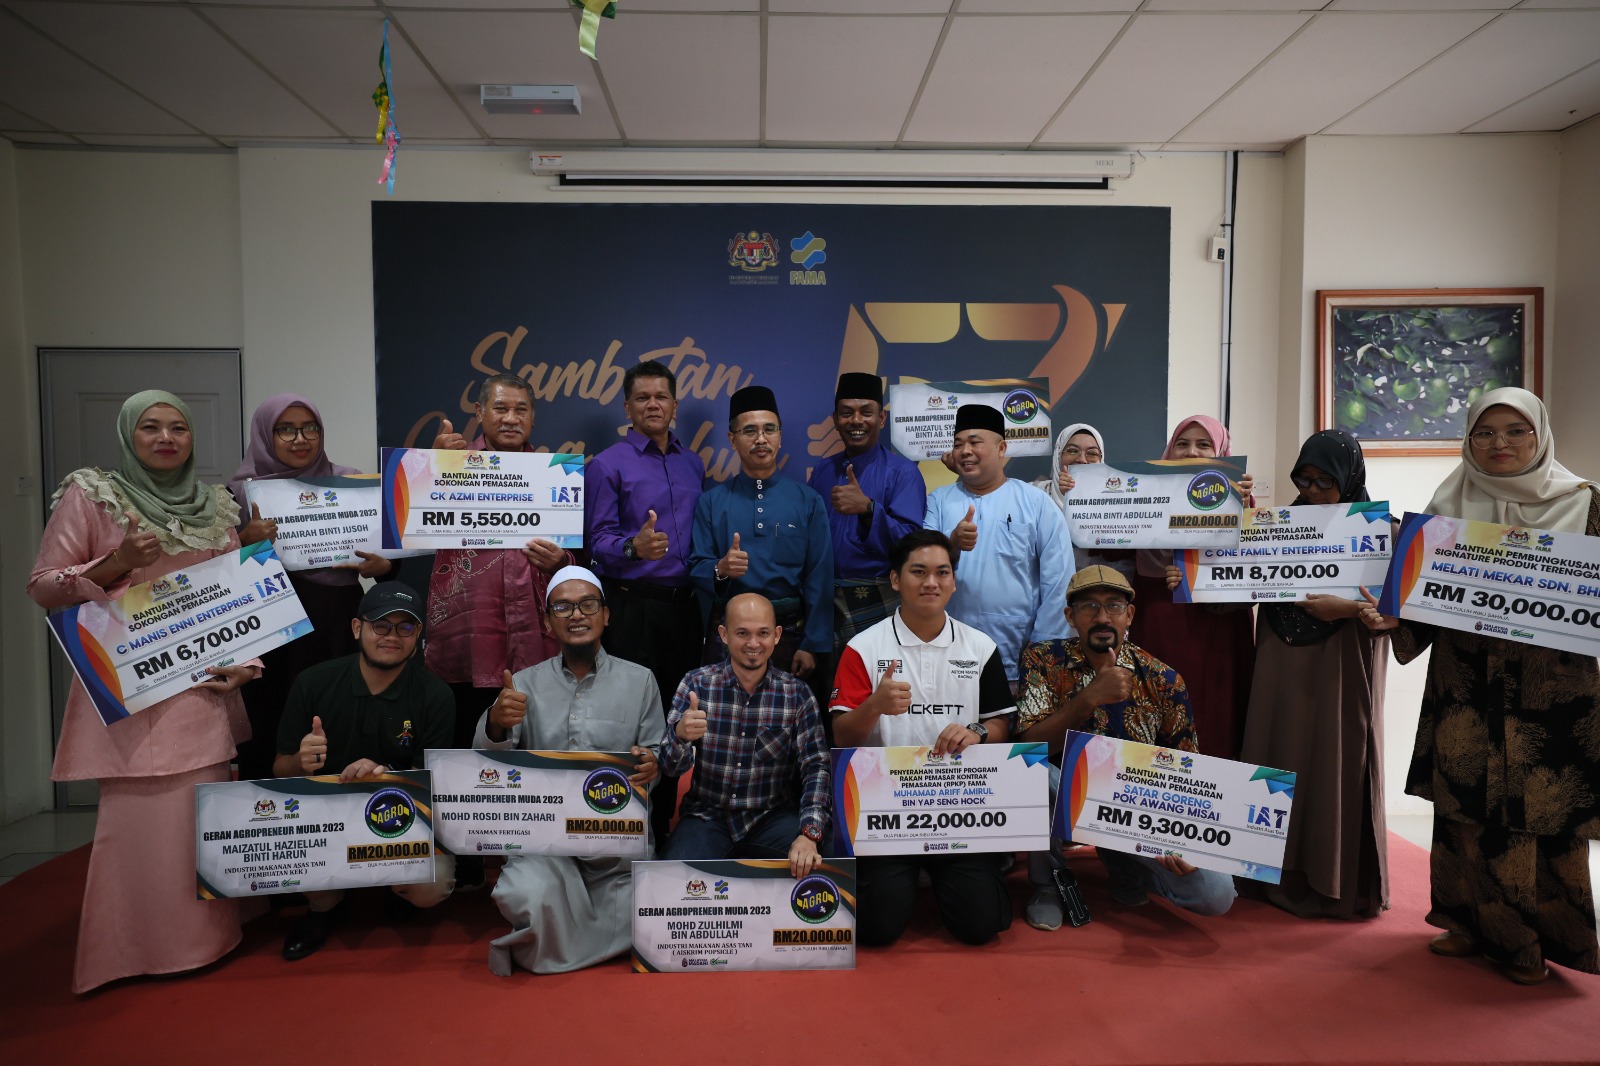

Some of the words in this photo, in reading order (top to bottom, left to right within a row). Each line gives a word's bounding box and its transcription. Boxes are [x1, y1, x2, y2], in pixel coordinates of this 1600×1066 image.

[790, 271, 826, 285] FAMA
[460, 326, 754, 413] Sambtan
[1012, 401, 1030, 414] AGRO
[1005, 428, 1048, 438] 20,000.00
[430, 492, 446, 500] CK
[478, 493, 533, 501] ENTERPRISE
[1196, 485, 1220, 498] AGRO
[285, 512, 337, 524] AGROPRENEUR
[338, 510, 358, 519] MUDA
[423, 512, 454, 525] RM
[461, 513, 540, 528] 5,550.00
[1170, 516, 1238, 526] RM20,000.00
[319, 527, 340, 537] BINTI
[343, 524, 368, 534] JUSOH
[1205, 549, 1213, 557] C
[1217, 548, 1238, 556] ONE
[1241, 547, 1278, 556] FAMILY
[1282, 545, 1344, 554] ENTERPRISE
[1435, 548, 1490, 563] SIGNATURE
[1493, 557, 1537, 570] PRODUK
[1455, 543, 1503, 556] BANTUAN
[1506, 552, 1600, 570] PEMBUNGKUSAN
[1212, 567, 1243, 580] RM
[1250, 564, 1339, 582] 8,700.00
[1431, 561, 1479, 577] MELATI
[1483, 572, 1534, 586] MEKAR
[1537, 579, 1571, 593] SDN.
[1577, 584, 1600, 597] BH
[1423, 582, 1465, 603] RM
[128, 606, 180, 632] SOKONGAN
[180, 588, 231, 612] PEMASARAN
[133, 601, 173, 621] BANTUAN
[174, 583, 221, 604] PERALATAN
[116, 645, 128, 655] C
[129, 629, 167, 650] MANIS
[170, 617, 196, 635] ENNI
[198, 594, 255, 623] ENTERPRISE
[133, 651, 174, 679] RM
[177, 616, 260, 659] 6,700.00
[1116, 773, 1167, 788] SOKONGAN
[1169, 784, 1223, 800] PEMASARAN
[1126, 767, 1166, 781] BANTUAN
[1168, 775, 1216, 790] PERALATAN
[432, 794, 458, 803] GERAN
[460, 794, 516, 803] AGROPRENEUR
[518, 795, 542, 804] MUDA
[543, 796, 563, 804] 2023
[594, 783, 620, 800] AGRO
[894, 789, 936, 797] MUHAMAD
[1124, 784, 1158, 798] SATAR
[1162, 792, 1212, 809] GORENG
[377, 804, 404, 824] AGRO
[1113, 792, 1137, 805] POK
[1140, 798, 1185, 814] AWANG
[1187, 808, 1220, 822] MISAI
[442, 812, 470, 821] MOHD
[472, 812, 501, 821] ROSDI
[522, 813, 555, 821] ZAHARI
[867, 814, 900, 830] RM
[907, 812, 1006, 831] 22,000.00
[204, 831, 232, 841] GERAN
[233, 827, 295, 839] AGROPRENEUR
[296, 825, 321, 835] MUDA
[323, 823, 344, 833] 2023
[566, 819, 643, 832] RM20,000.00
[1097, 805, 1132, 827] RM
[1138, 814, 1231, 846] 9,300.00
[223, 842, 272, 854] MAIZATUL
[274, 838, 327, 850] HAZIELLAH
[349, 843, 429, 860] RM20,000.00
[244, 852, 270, 862] BINTI
[273, 850, 307, 860] HARUN
[802, 891, 828, 909] AGRO
[639, 907, 665, 916] GERAN
[666, 907, 723, 916] AGROPRENEUR
[725, 907, 748, 916] MUDA
[750, 906, 770, 915] 2023
[668, 921, 695, 930] MOHD
[698, 921, 742, 929] ZULHILMI
[671, 930, 688, 939] BIN
[690, 930, 739, 939] ABDULLAH
[774, 930, 852, 943] RM20,000.00
